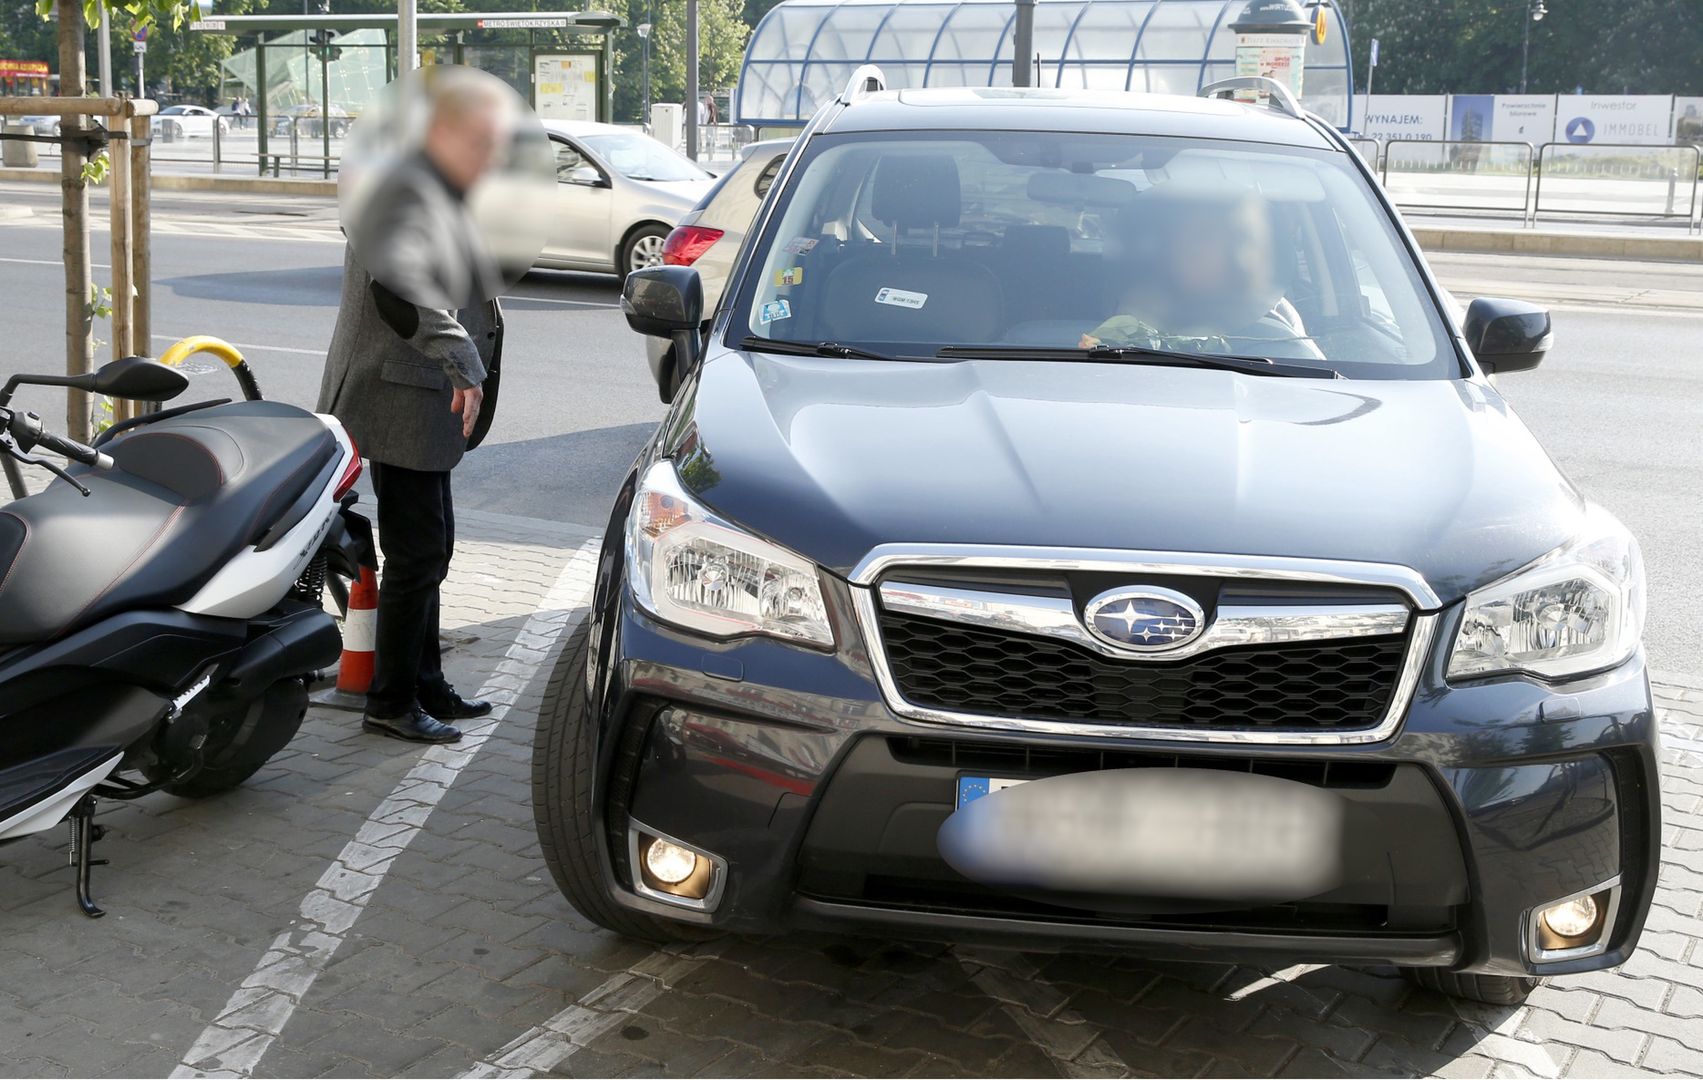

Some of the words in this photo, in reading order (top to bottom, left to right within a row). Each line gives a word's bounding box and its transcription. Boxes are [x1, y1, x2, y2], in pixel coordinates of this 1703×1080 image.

[1590, 101, 1637, 111] Inwestor
[1365, 114, 1423, 124] WYNAJEM:
[1603, 123, 1658, 136] IMMOBEL
